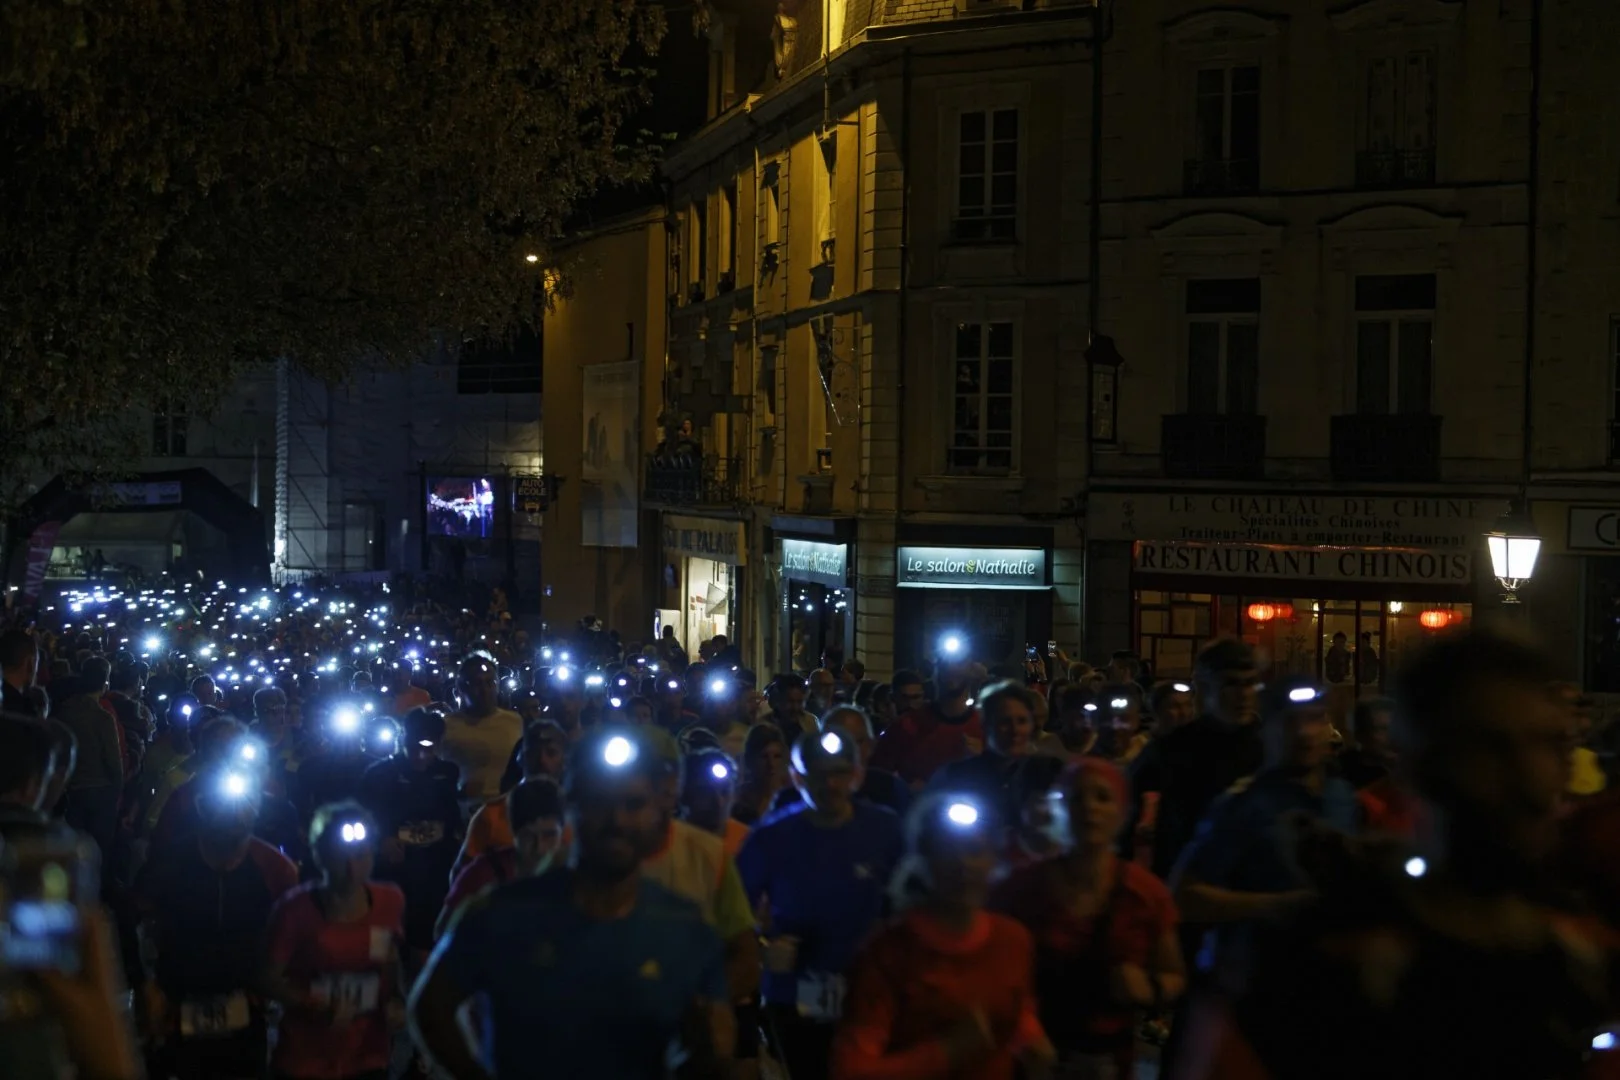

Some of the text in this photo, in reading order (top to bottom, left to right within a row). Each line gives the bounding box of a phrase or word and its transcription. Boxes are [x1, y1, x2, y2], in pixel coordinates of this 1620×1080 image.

[1169, 496, 1196, 513] LE
[1344, 499, 1376, 516] DE
[1394, 500, 1480, 518] CHINE
[1329, 515, 1400, 529] Chinoises
[1596, 513, 1620, 545] C
[907, 557, 923, 572] Le
[927, 557, 965, 573] salon
[975, 559, 1036, 575] Nathalie
[1141, 545, 1467, 580] RESTAURANT CHINOIS
